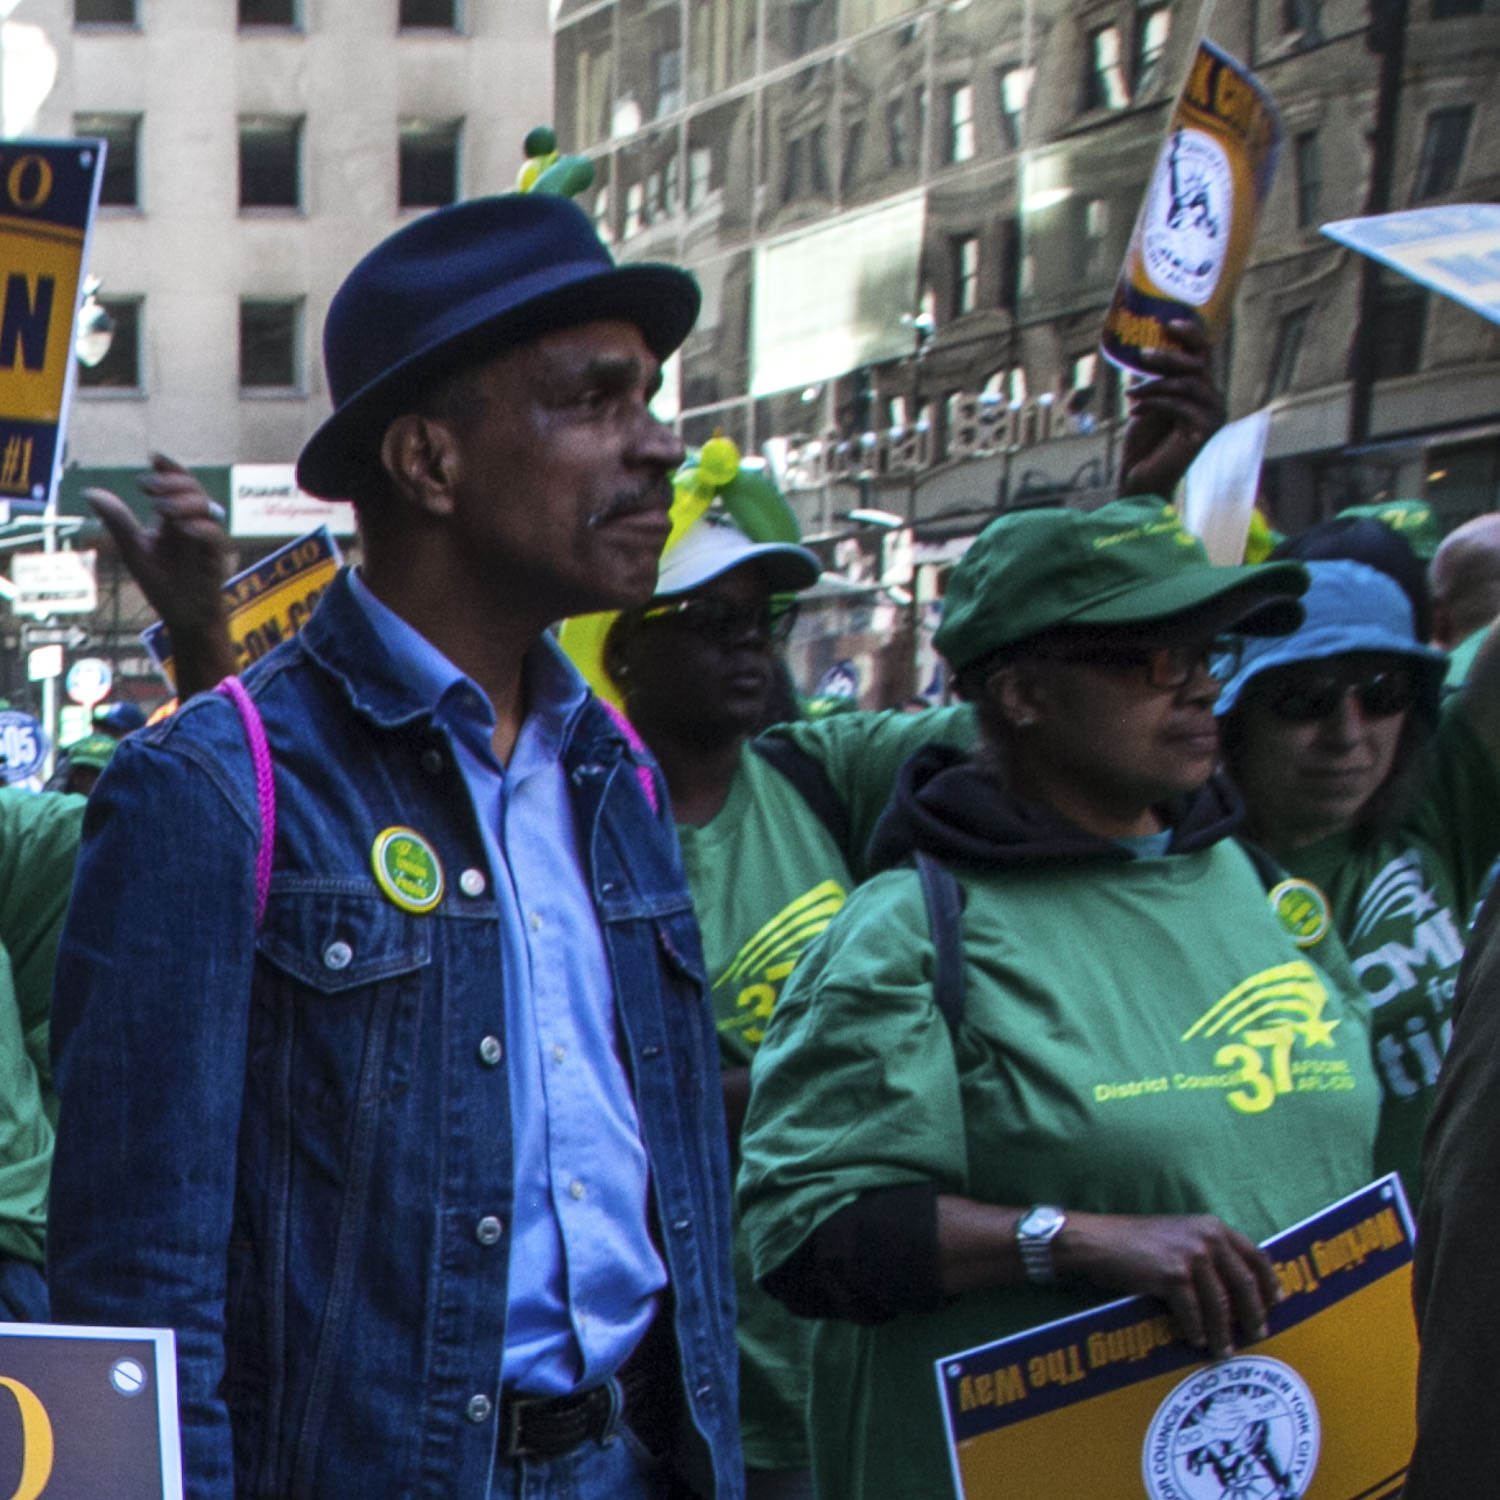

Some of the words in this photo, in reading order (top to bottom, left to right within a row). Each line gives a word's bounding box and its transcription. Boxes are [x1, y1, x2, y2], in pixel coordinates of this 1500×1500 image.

[1, 436, 35, 483] #1
[1094, 1076, 1169, 1102] District
[1213, 1022, 1295, 1113] 37
[959, 1363, 1027, 1412] Way
[1029, 1343, 1087, 1388] The
[1153, 1403, 1187, 1476] COUNCIL
[1291, 1440, 1311, 1478] CITY
